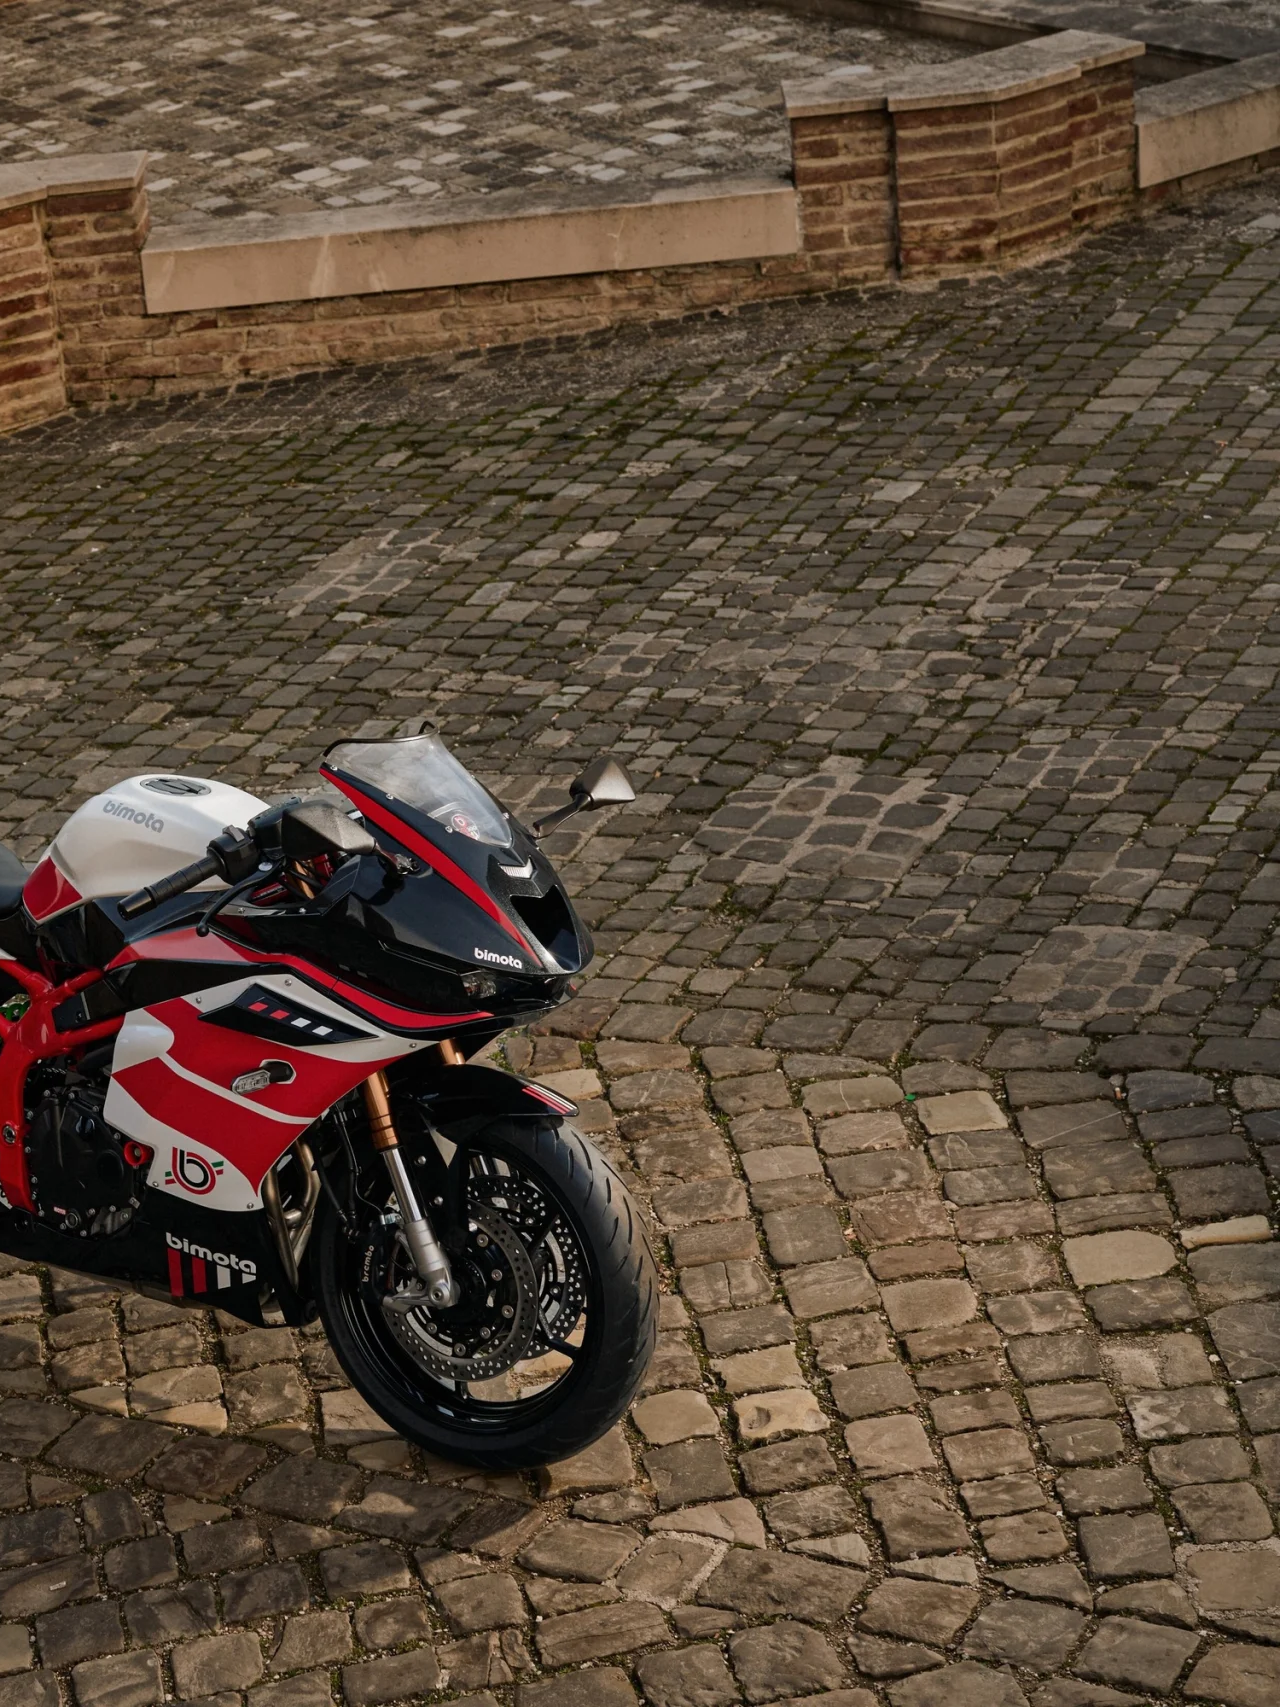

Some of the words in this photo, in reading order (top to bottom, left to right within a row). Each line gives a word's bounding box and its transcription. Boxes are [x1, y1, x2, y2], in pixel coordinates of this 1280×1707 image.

[102, 800, 165, 834] bimota
[474, 947, 523, 970] bimota
[165, 1231, 257, 1274] bimota
[361, 1245, 375, 1283] brembo
